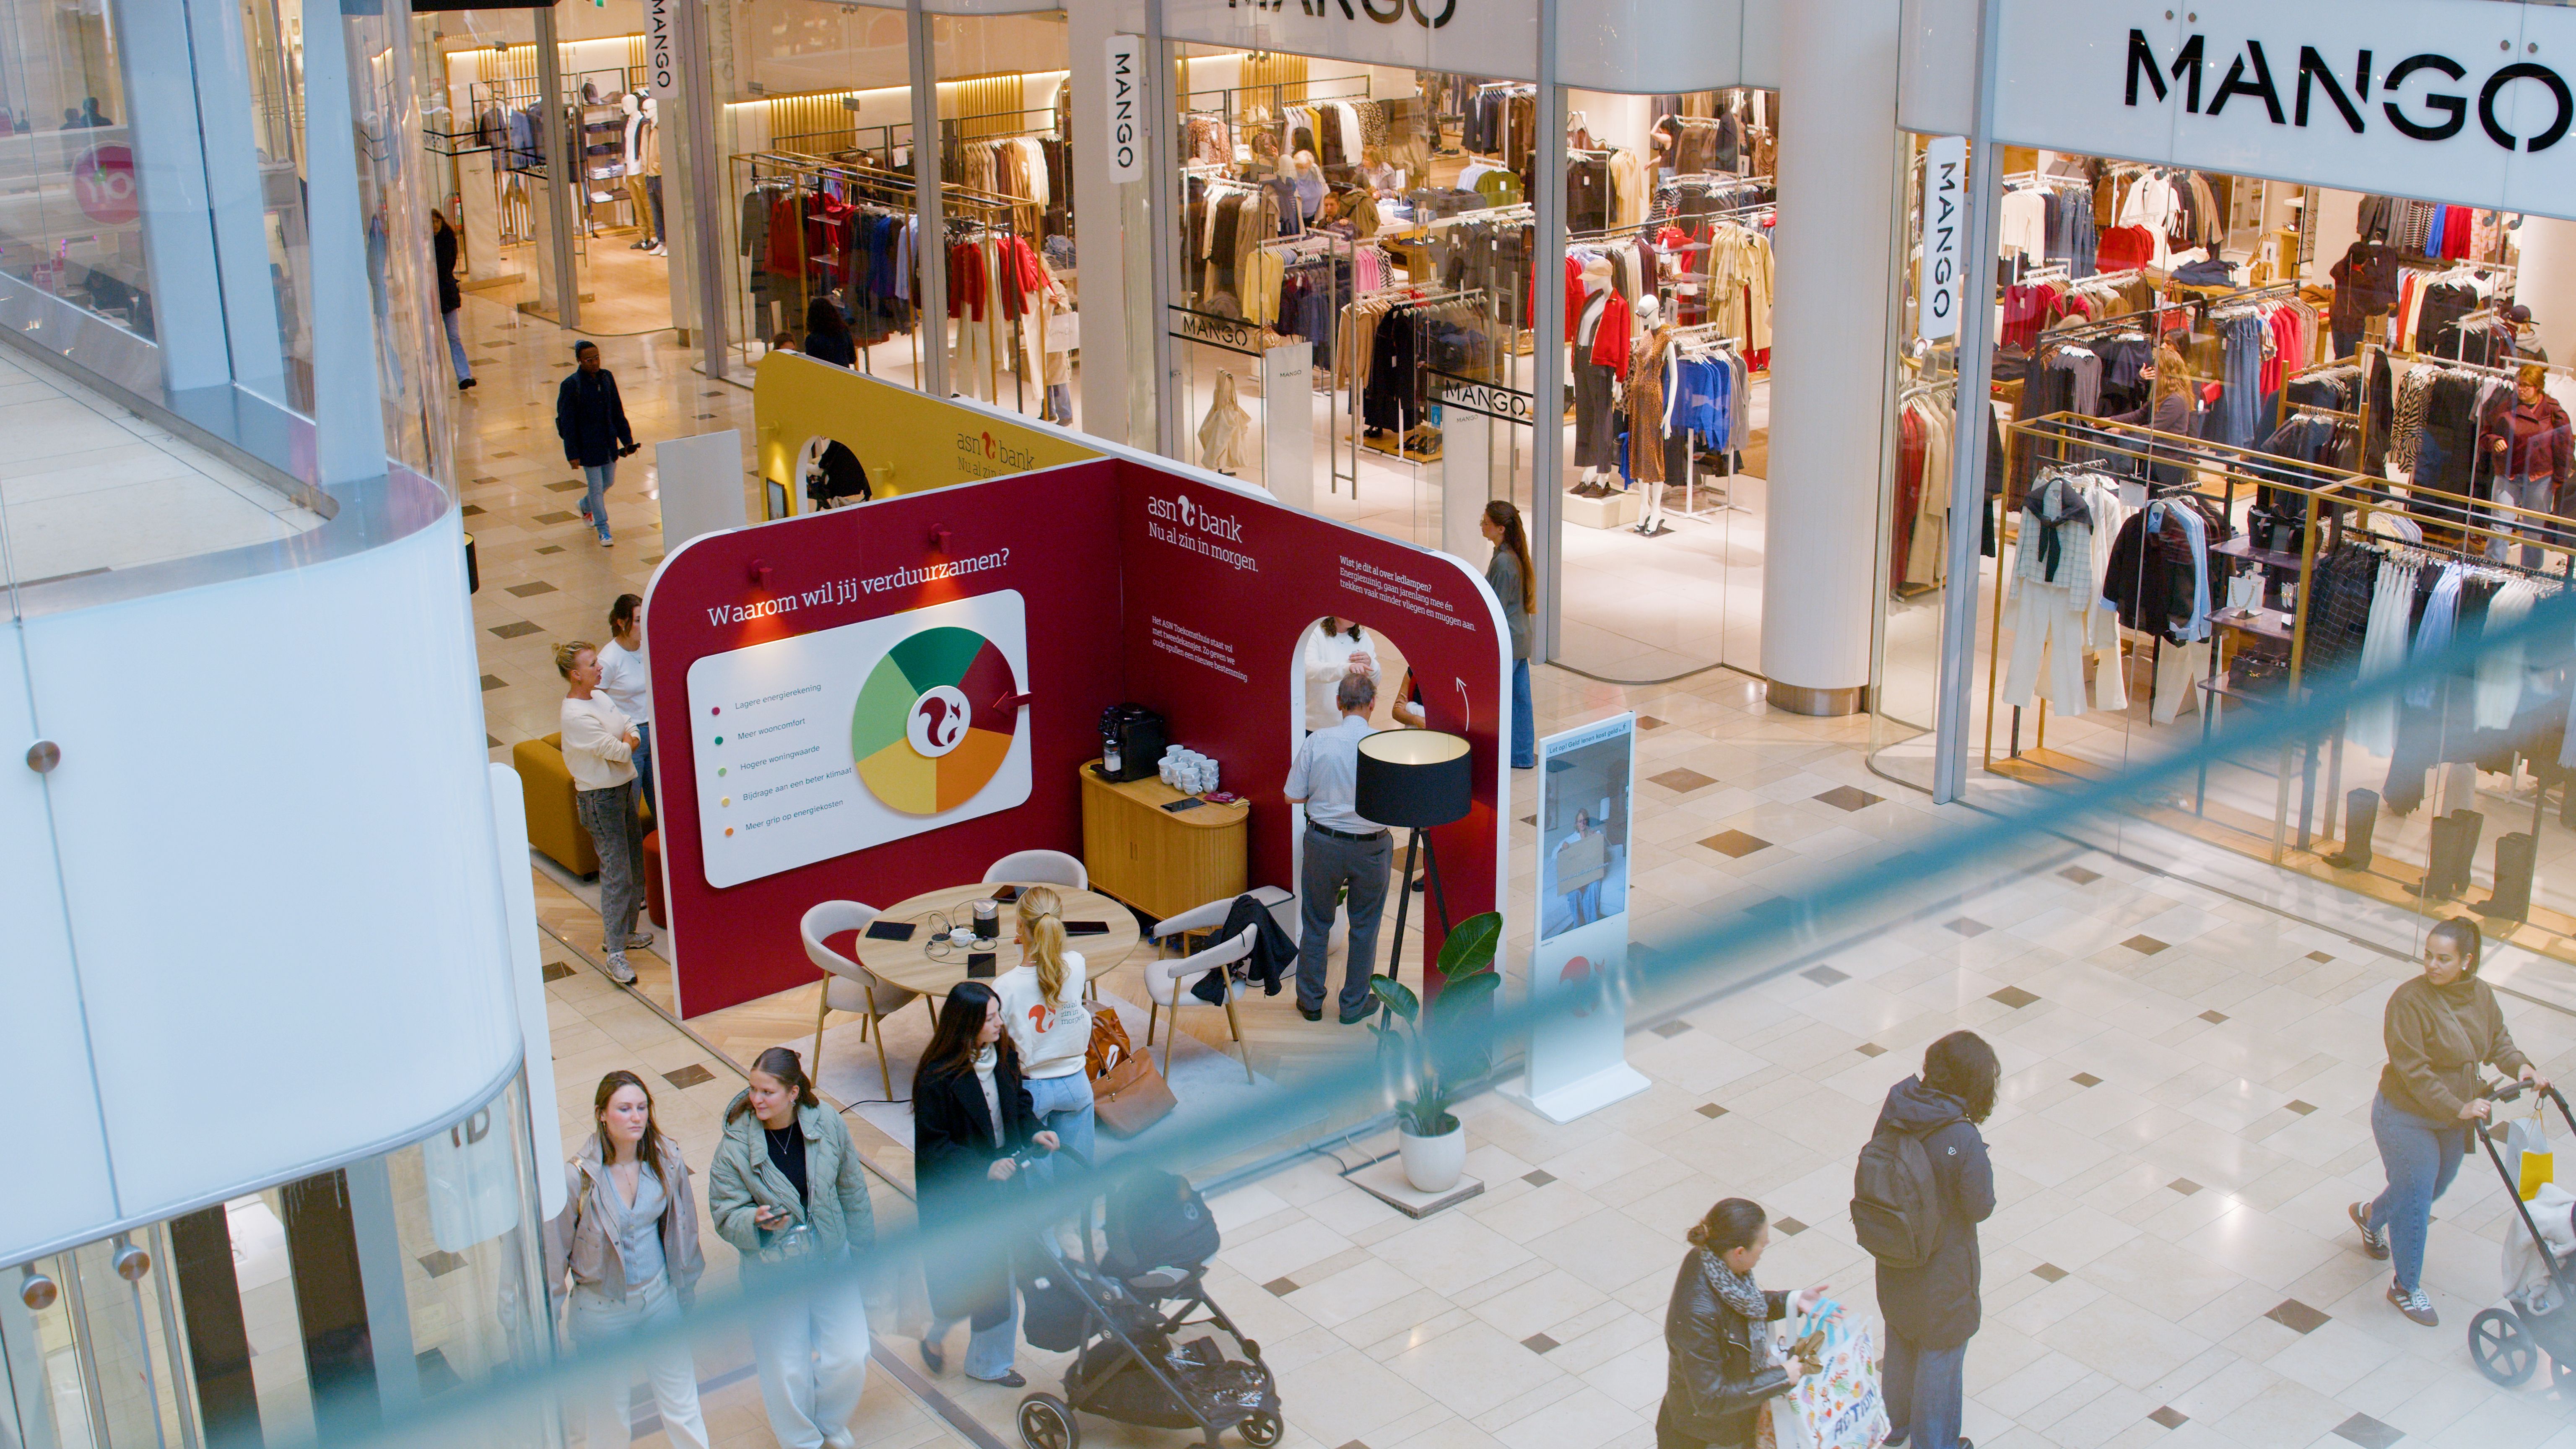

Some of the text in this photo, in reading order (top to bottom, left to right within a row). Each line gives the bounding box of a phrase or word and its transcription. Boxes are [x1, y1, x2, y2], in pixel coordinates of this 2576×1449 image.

[652, 0, 670, 87] MANGO
[2125, 29, 2574, 153] MANGO
[1115, 53, 1133, 168] MANGO
[1933, 162, 1956, 318] MANGO
[1184, 316, 1247, 346] MANGO
[1280, 369, 1301, 378] MANGO
[1446, 379, 1526, 416] MANGO
[1457, 414, 1478, 423] MANGO
[958, 433, 1035, 470] asn bank
[958, 456, 971, 473] Nu
[973, 461, 981, 477] al
[1148, 496, 1242, 543] asn bank
[1149, 521, 1258, 572] Nu al zin in morgen.
[707, 548, 1010, 627] Waarom wil jij verduurzamen?
[1340, 555, 1432, 592] Wist je dit al over ledlampen?
[1340, 567, 1453, 612] Energiezuinig, gaan jarenlang mee én
[1340, 579, 1476, 631] trekken vaak minder vliegen en muggen aan.
[1152, 615, 1233, 653] Het ASN Toekomsthuis staat vol
[1153, 628, 1235, 665] met tweedekansjes. Zo geven we
[1153, 639, 1248, 683] oude spullen een nieuwe bestemming
[735, 684, 821, 710] Lagere energierekening
[738, 718, 805, 740] Meer wooncomfort
[1568, 739, 1580, 748] Geld
[1581, 735, 1594, 744] lenen
[1607, 727, 1618, 737] geld
[740, 745, 820, 771] Hogere woningwaarde
[743, 787, 773, 801] Bijdrage
[775, 784, 788, 792] aan
[805, 774, 824, 784] beter
[826, 767, 852, 779] klimaat
[745, 799, 844, 831] Meer grip op energiekosten
[1061, 1013, 1084, 1024] morgen
